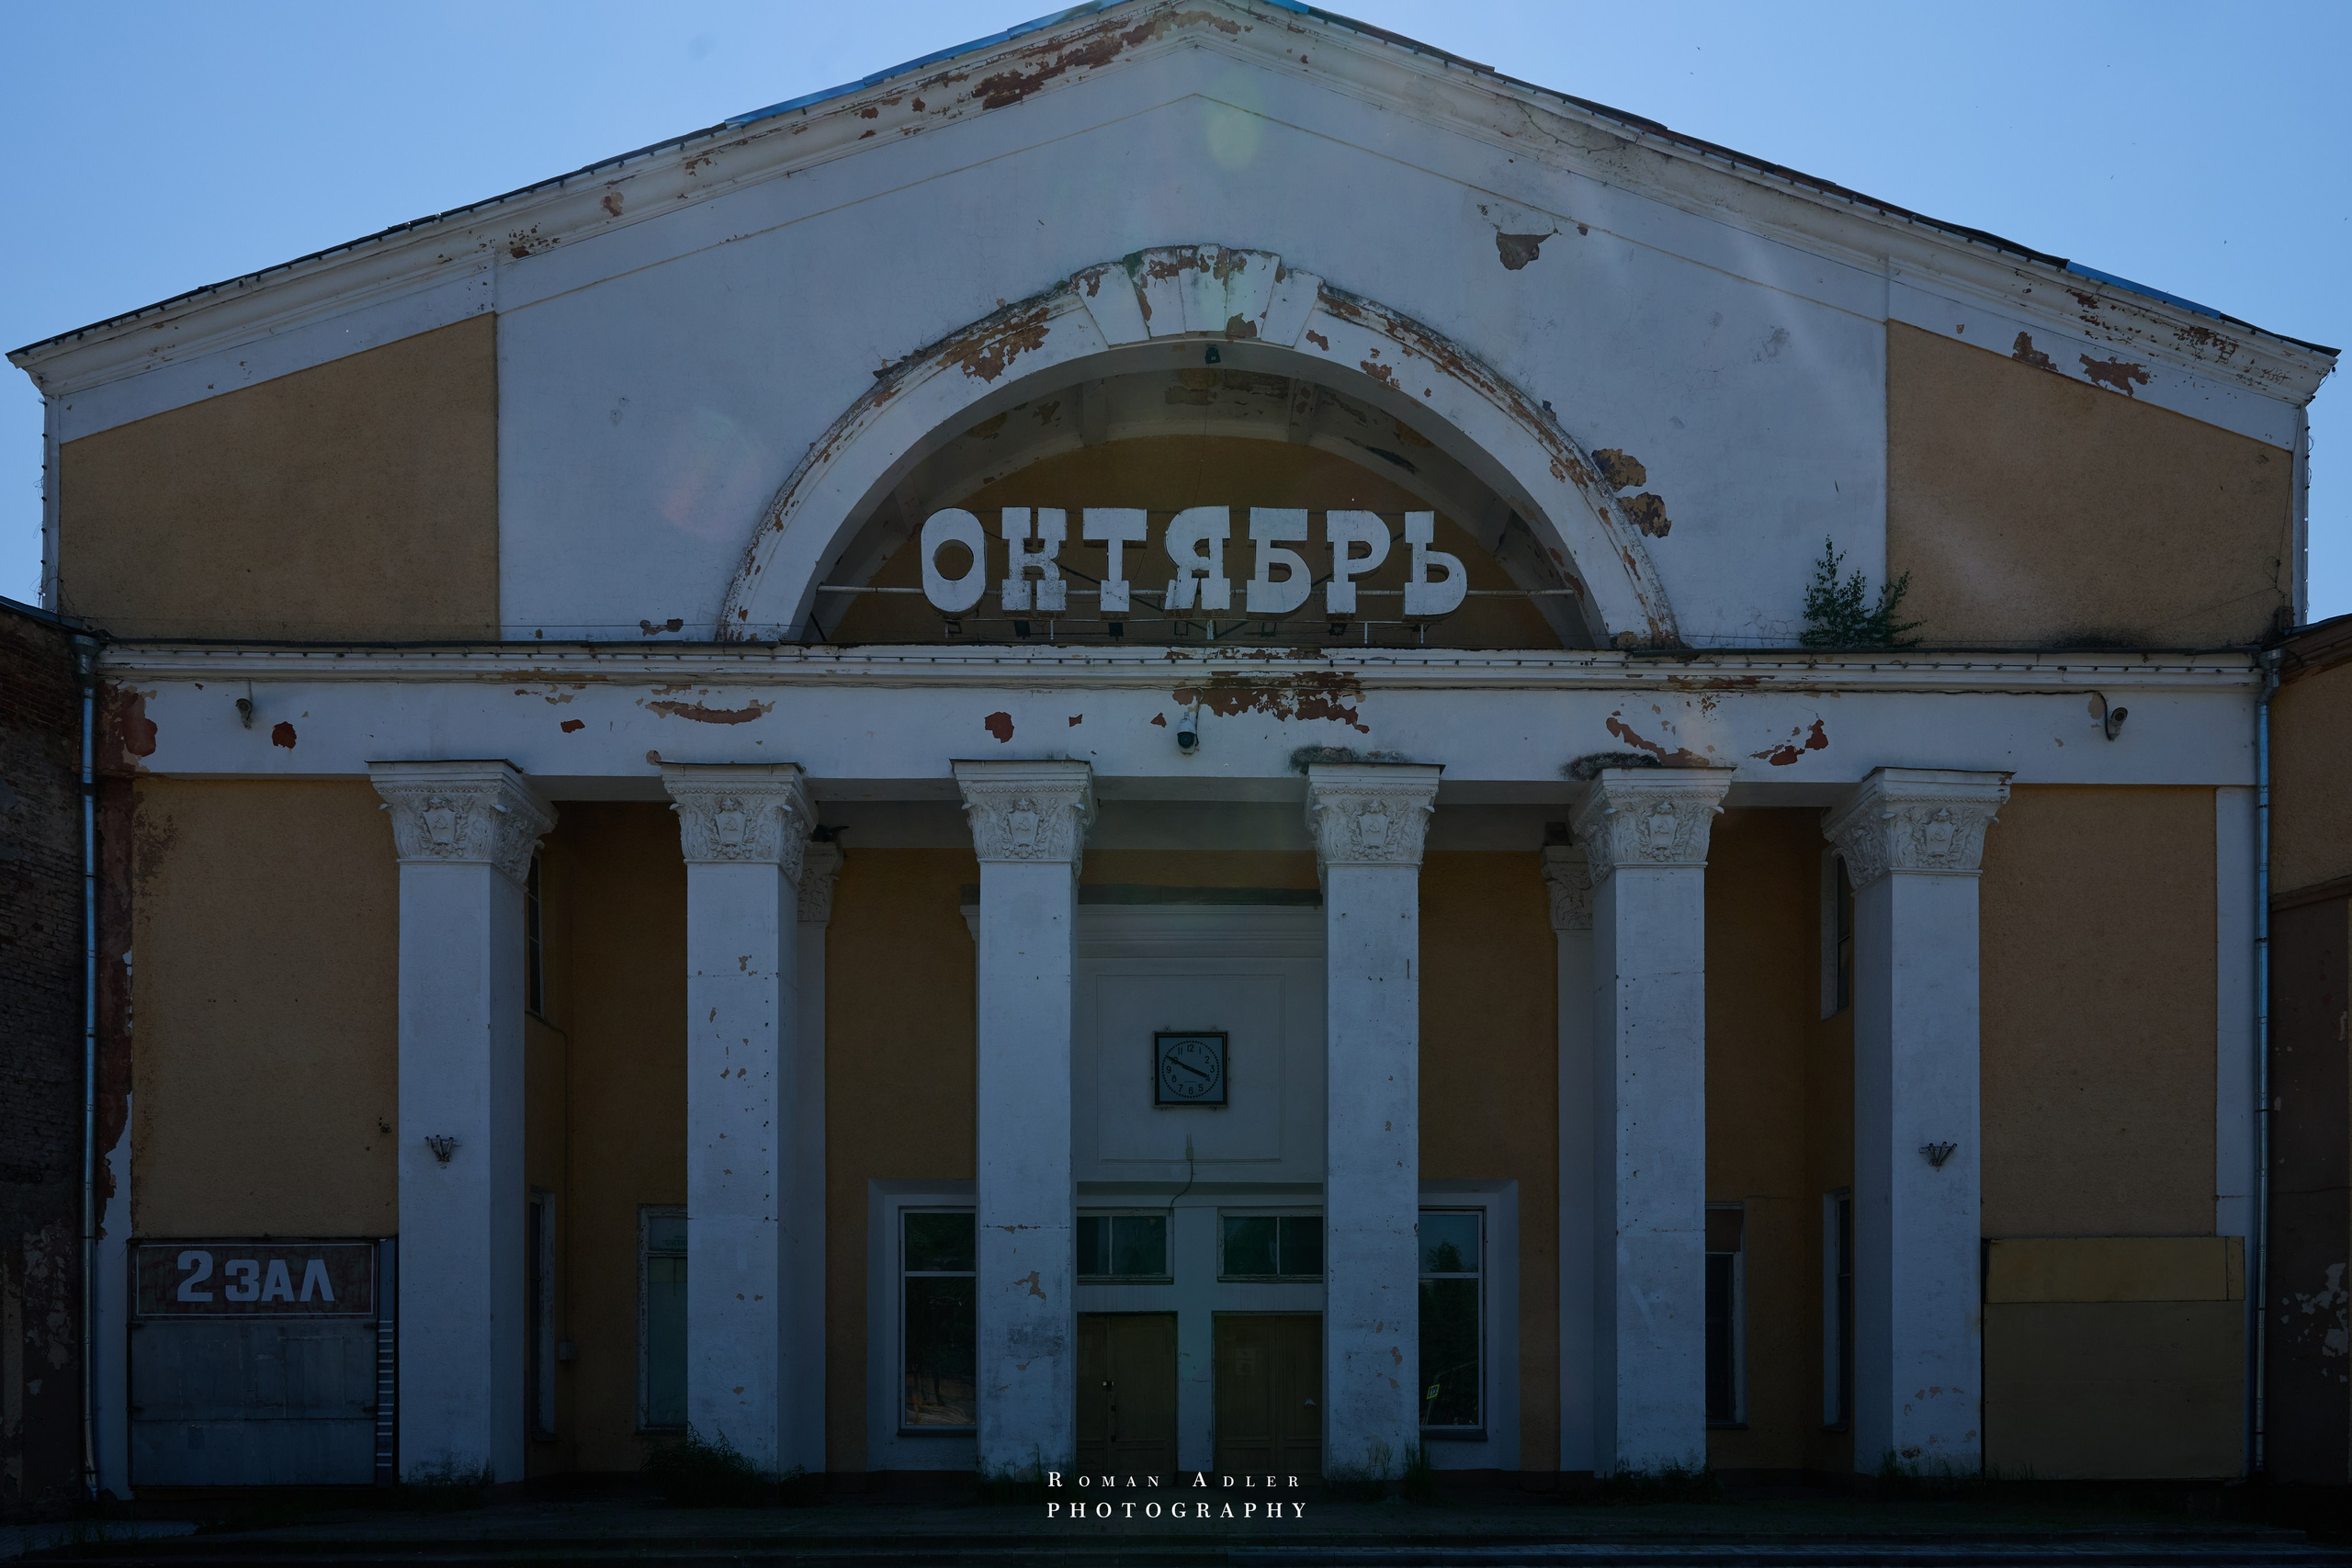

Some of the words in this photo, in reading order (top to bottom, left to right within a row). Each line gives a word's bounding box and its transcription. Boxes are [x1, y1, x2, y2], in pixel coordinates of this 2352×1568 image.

[920, 504, 1469, 616] ОКТЯБРЬ
[1178, 1047, 1183, 1055] 11
[1187, 1043, 1194, 1053] 12
[1204, 1055, 1210, 1065] 2
[1166, 1066, 1171, 1074] 9
[1209, 1065, 1216, 1073] 3
[1171, 1074, 1177, 1083] 8
[1178, 1084, 1183, 1092] 7
[1188, 1087, 1193, 1095] 6
[1198, 1083, 1204, 1092] 5
[176, 1249, 214, 1303] 2
[224, 1258, 335, 1303] ЗАЛ
